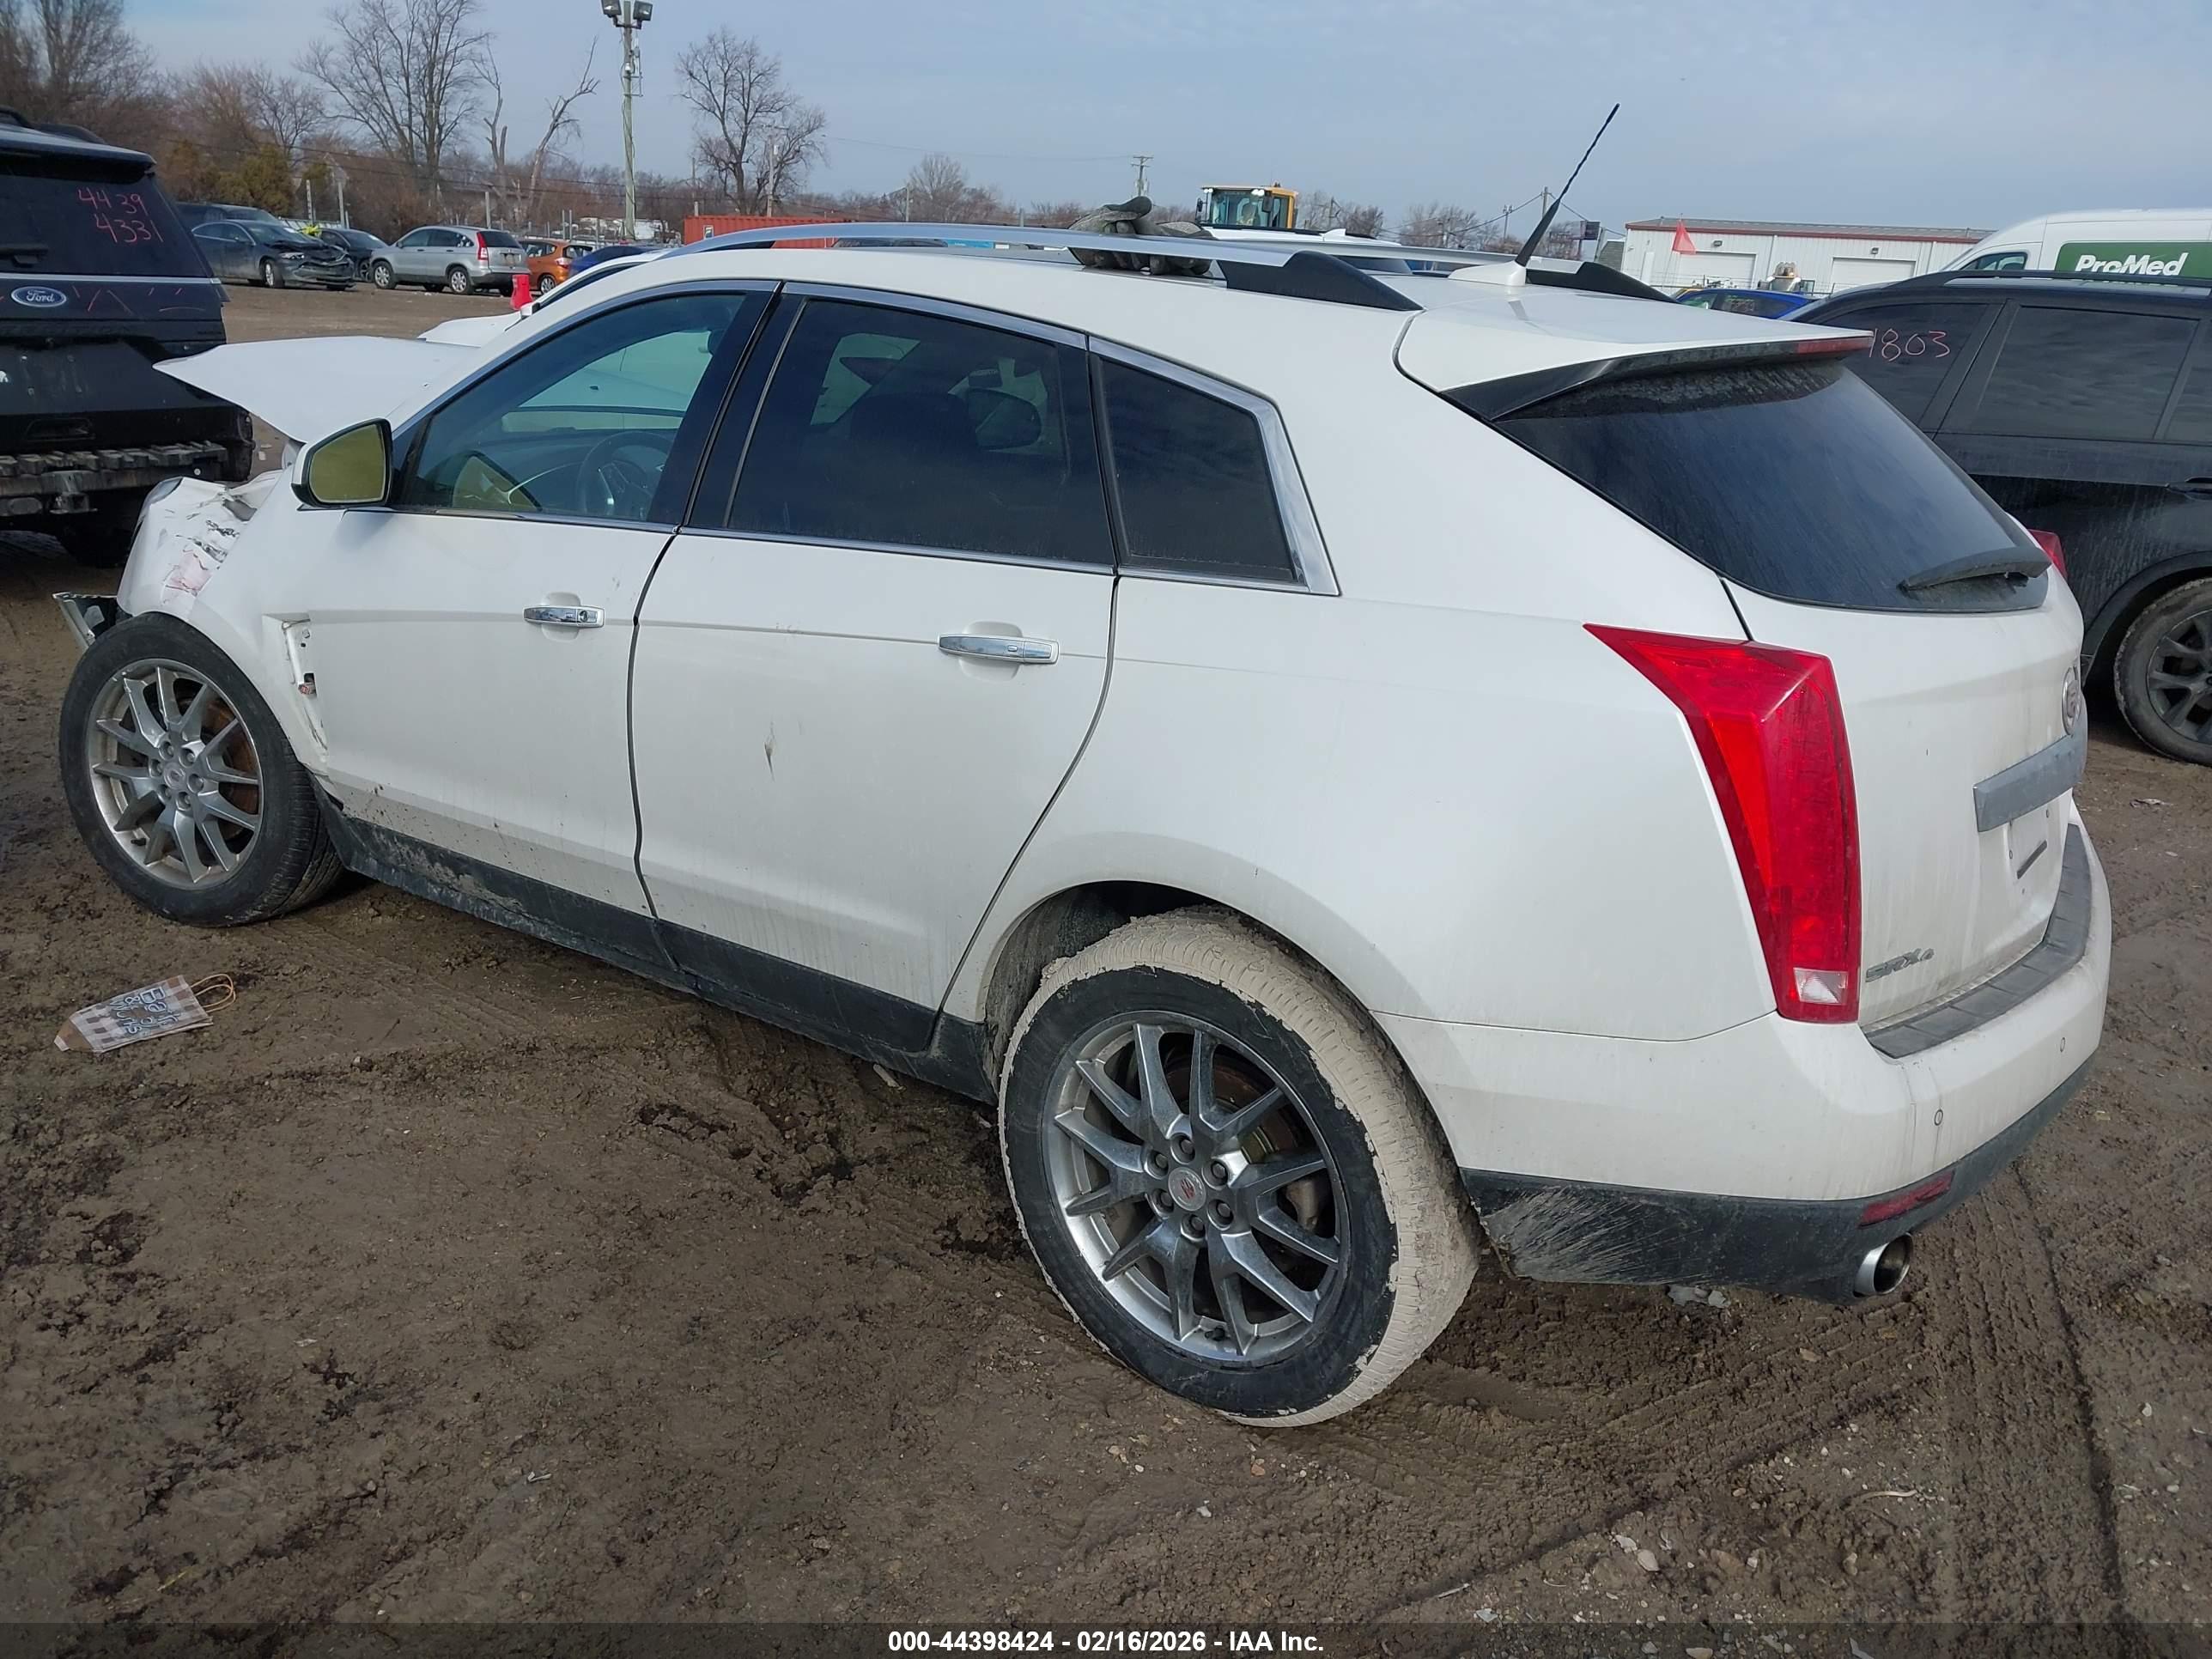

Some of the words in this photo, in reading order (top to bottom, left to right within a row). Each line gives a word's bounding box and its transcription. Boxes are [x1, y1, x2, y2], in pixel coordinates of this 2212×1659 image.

[94, 213, 164, 242] 4331
[2075, 252, 2189, 276] ProMed
[26, 289, 55, 302] Ford
